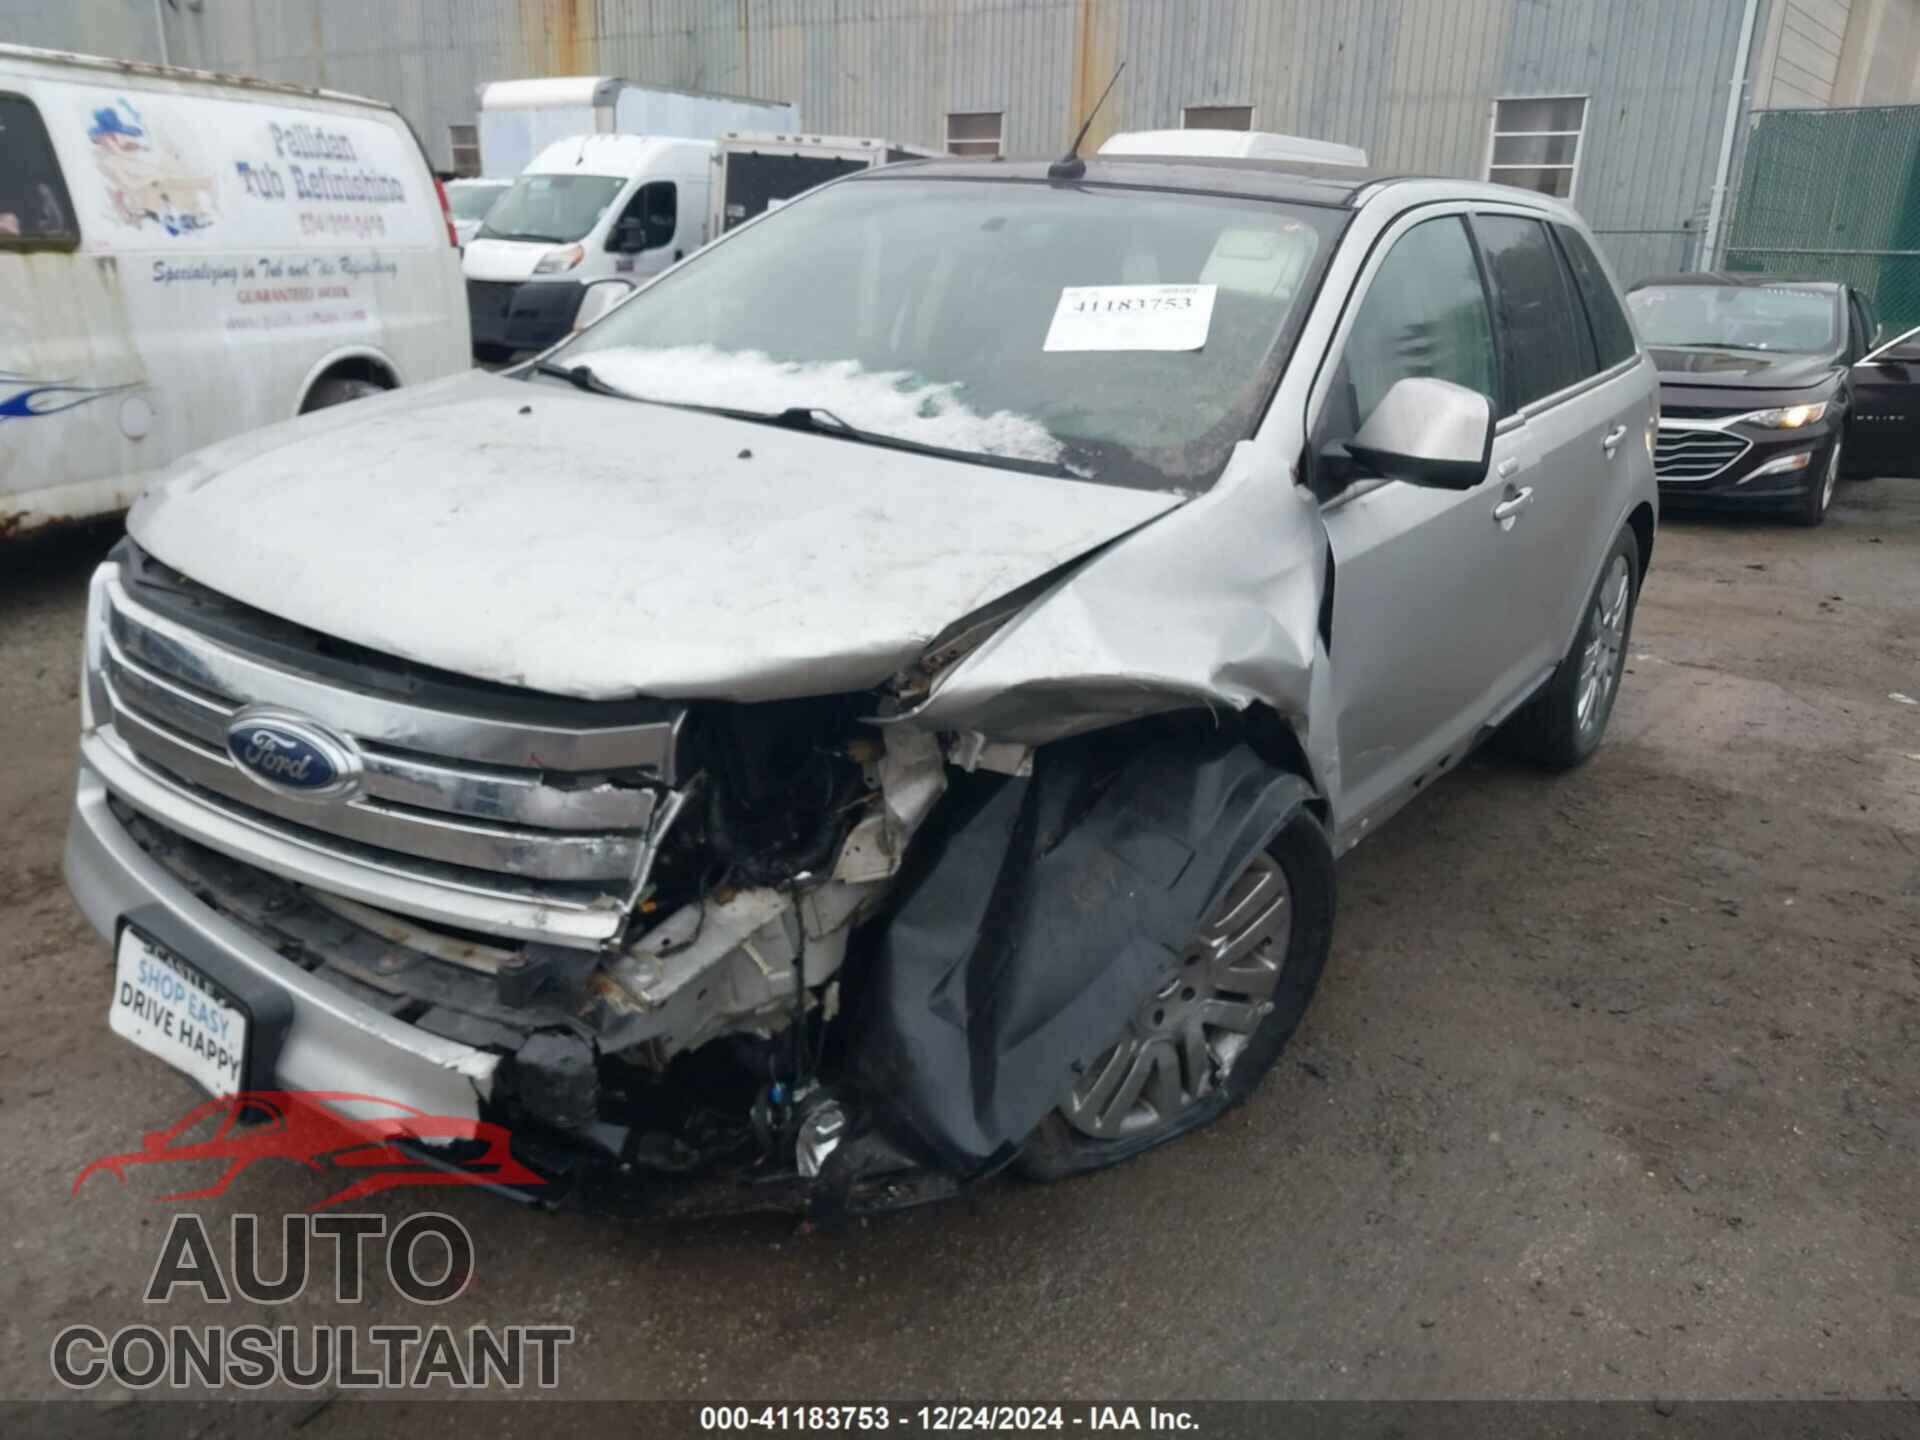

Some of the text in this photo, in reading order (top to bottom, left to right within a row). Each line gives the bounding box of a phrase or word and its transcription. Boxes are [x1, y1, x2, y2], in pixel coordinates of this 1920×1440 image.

[152, 260, 238, 285] Specializing
[243, 264, 256, 279] in
[1073, 296, 1193, 313] 41183753
[246, 729, 313, 780] Ford
[138, 958, 185, 1004] SHOP
[188, 994, 230, 1040] EASY
[120, 980, 241, 1081] DRIVE HAPPY
